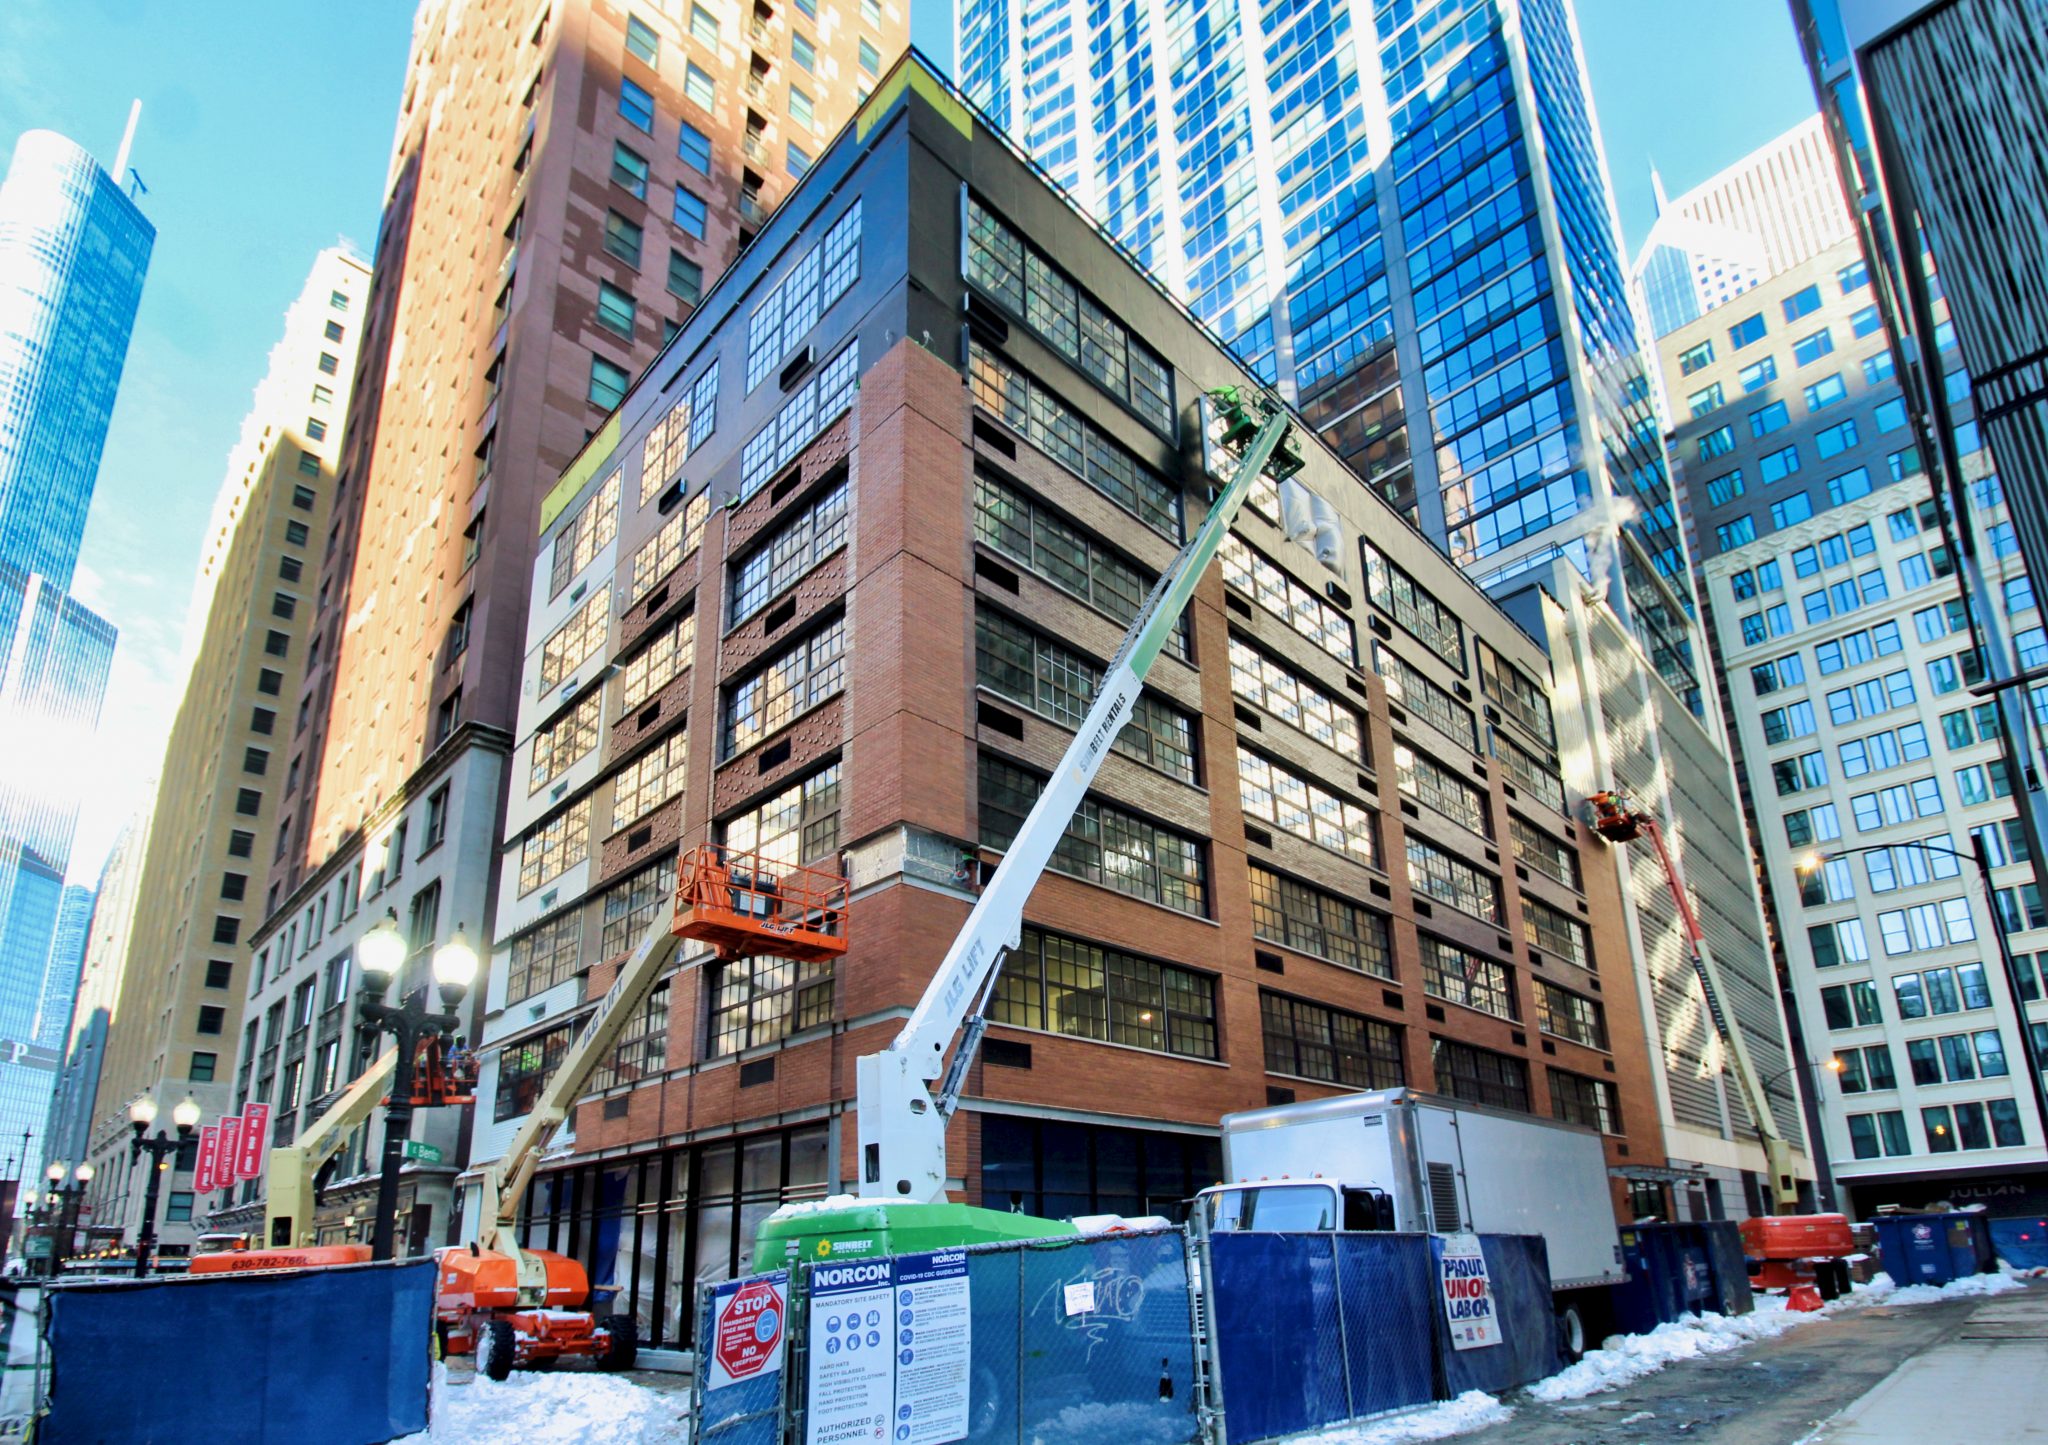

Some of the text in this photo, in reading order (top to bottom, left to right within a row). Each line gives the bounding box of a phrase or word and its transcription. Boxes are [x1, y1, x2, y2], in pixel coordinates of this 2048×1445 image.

[1101, 692, 1126, 734] RENTALS
[962, 935, 984, 980] LIFT
[582, 976, 623, 1050] JLG LIFT
[1949, 1185, 2025, 1199] JULIAN
[832, 1239, 873, 1251] SUNBELT
[932, 1253, 965, 1264] NORCON
[815, 1263, 891, 1287] NORCON
[899, 1267, 966, 1281] COVID-19 CDC GUIDELINES
[1442, 1258, 1485, 1278] PROUD
[735, 1294, 771, 1315] STOP
[815, 1293, 890, 1308] MANDATORY SITE SAFETY
[1449, 1298, 1490, 1320] LABOR
[723, 1322, 755, 1334] FACE MASKS
[724, 1315, 755, 1327] MANDATORY
[741, 1346, 757, 1358] NO
[732, 1354, 764, 1367] EXCEPTIONS
[819, 1367, 865, 1379] SAFETY GLASSES
[833, 1376, 860, 1386] VISIBILITY
[860, 1372, 887, 1381] CLOTHING
[833, 1384, 867, 1394] PROTECTION
[835, 1392, 868, 1402] PROTECTION
[834, 1401, 868, 1411] PROTECTION
[817, 1417, 872, 1434] AUTHORIZED
[816, 1428, 868, 1445] PERSONNEL
